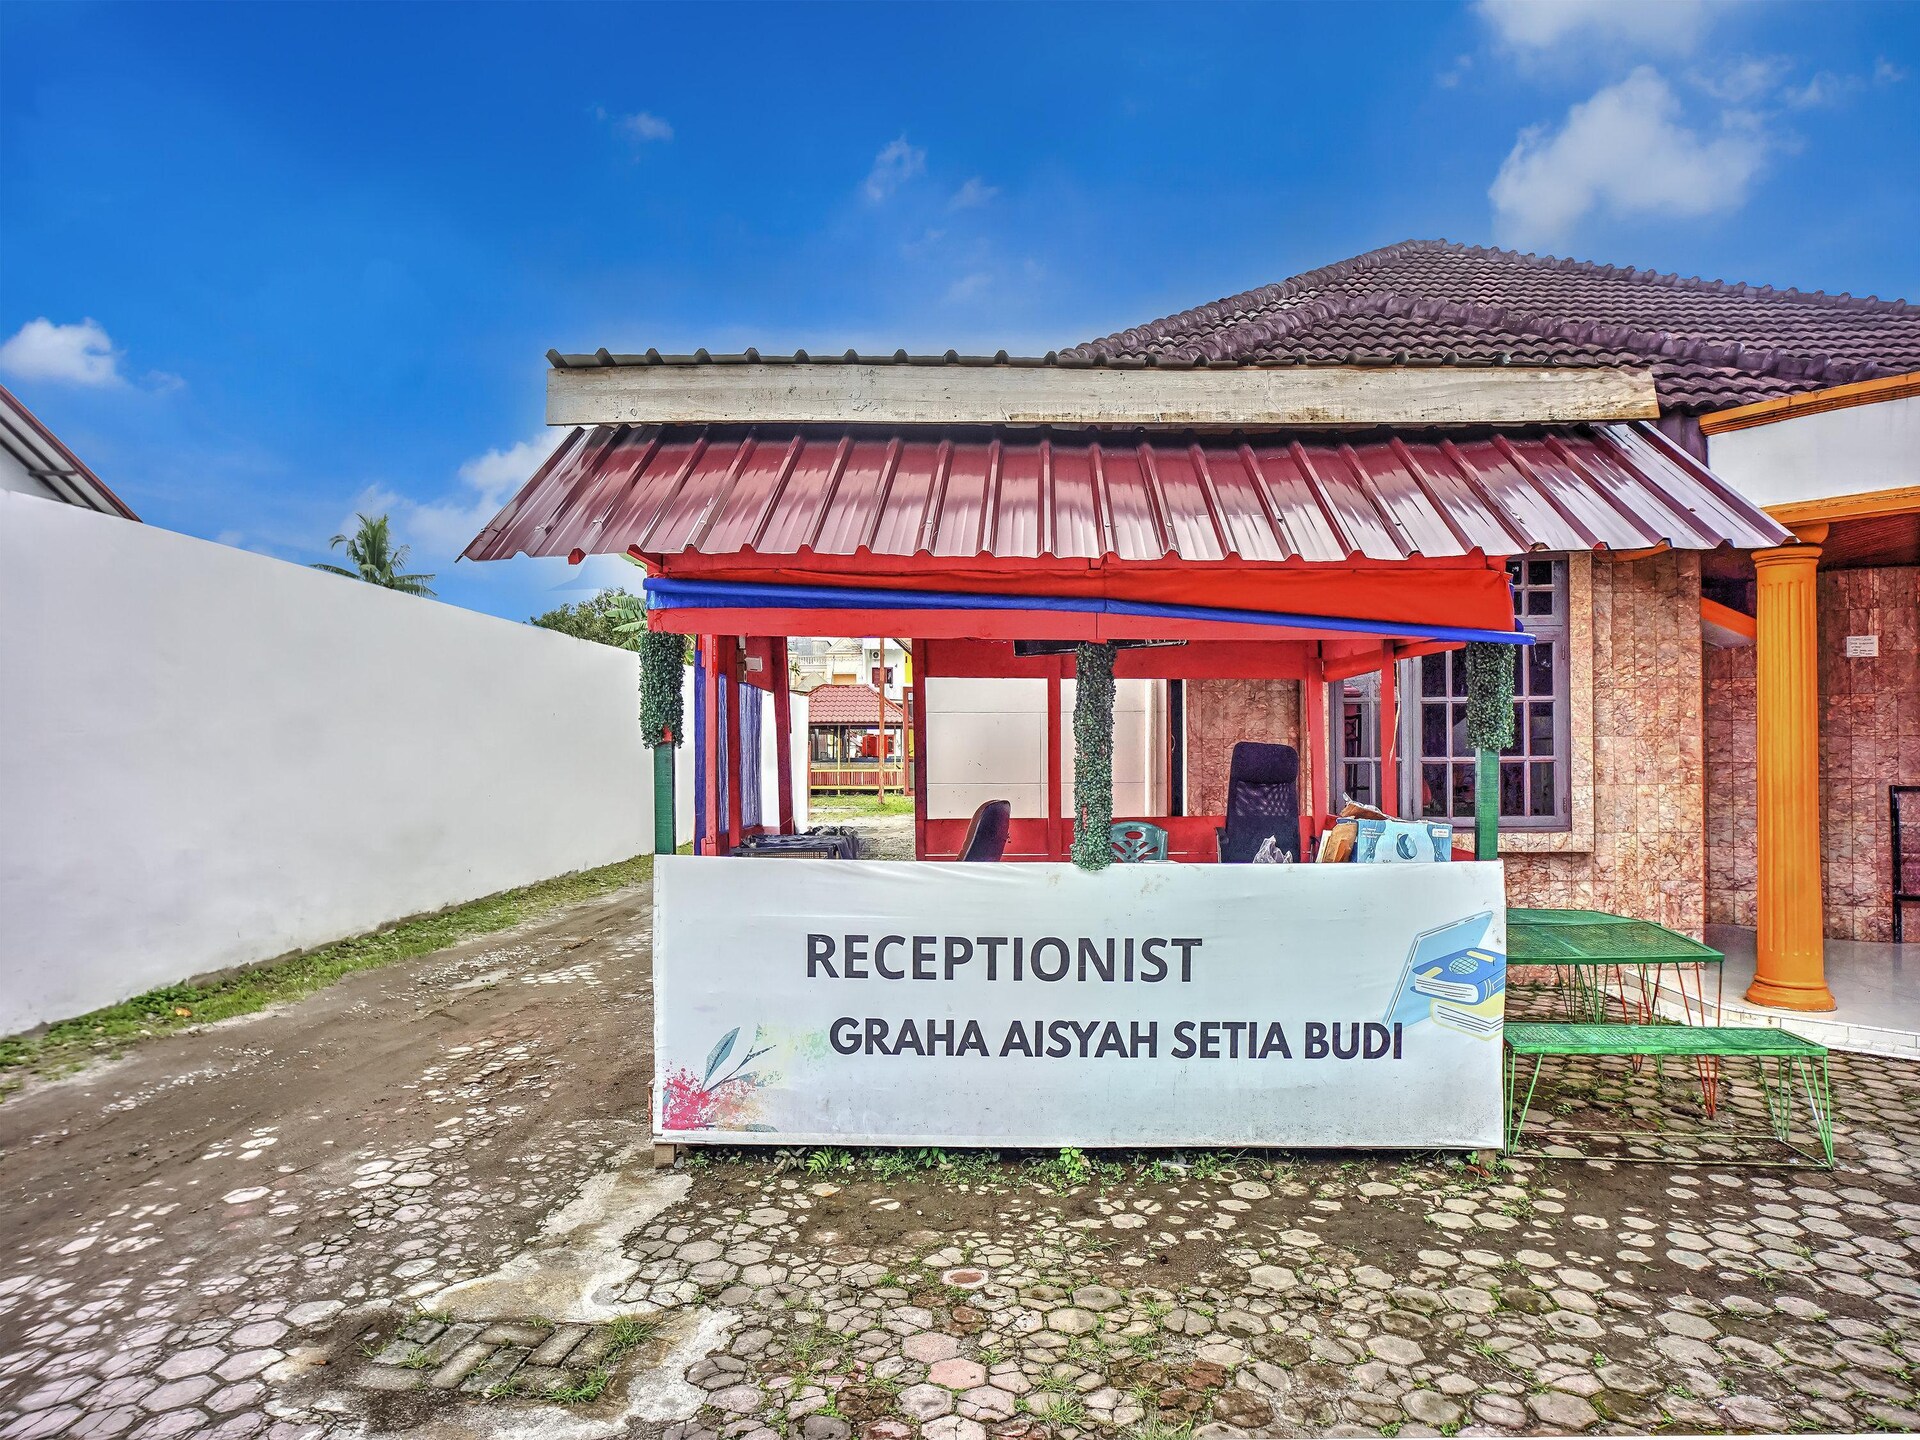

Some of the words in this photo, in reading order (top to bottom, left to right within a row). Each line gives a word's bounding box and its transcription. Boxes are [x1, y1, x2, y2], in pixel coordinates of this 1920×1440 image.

[806, 933, 1203, 984] RECEPTIONIST
[829, 1016, 990, 1058] GRAHA
[998, 1020, 1158, 1060] AISYAH
[1170, 1020, 1293, 1060] SETIA
[1304, 1021, 1404, 1060] BUDI
